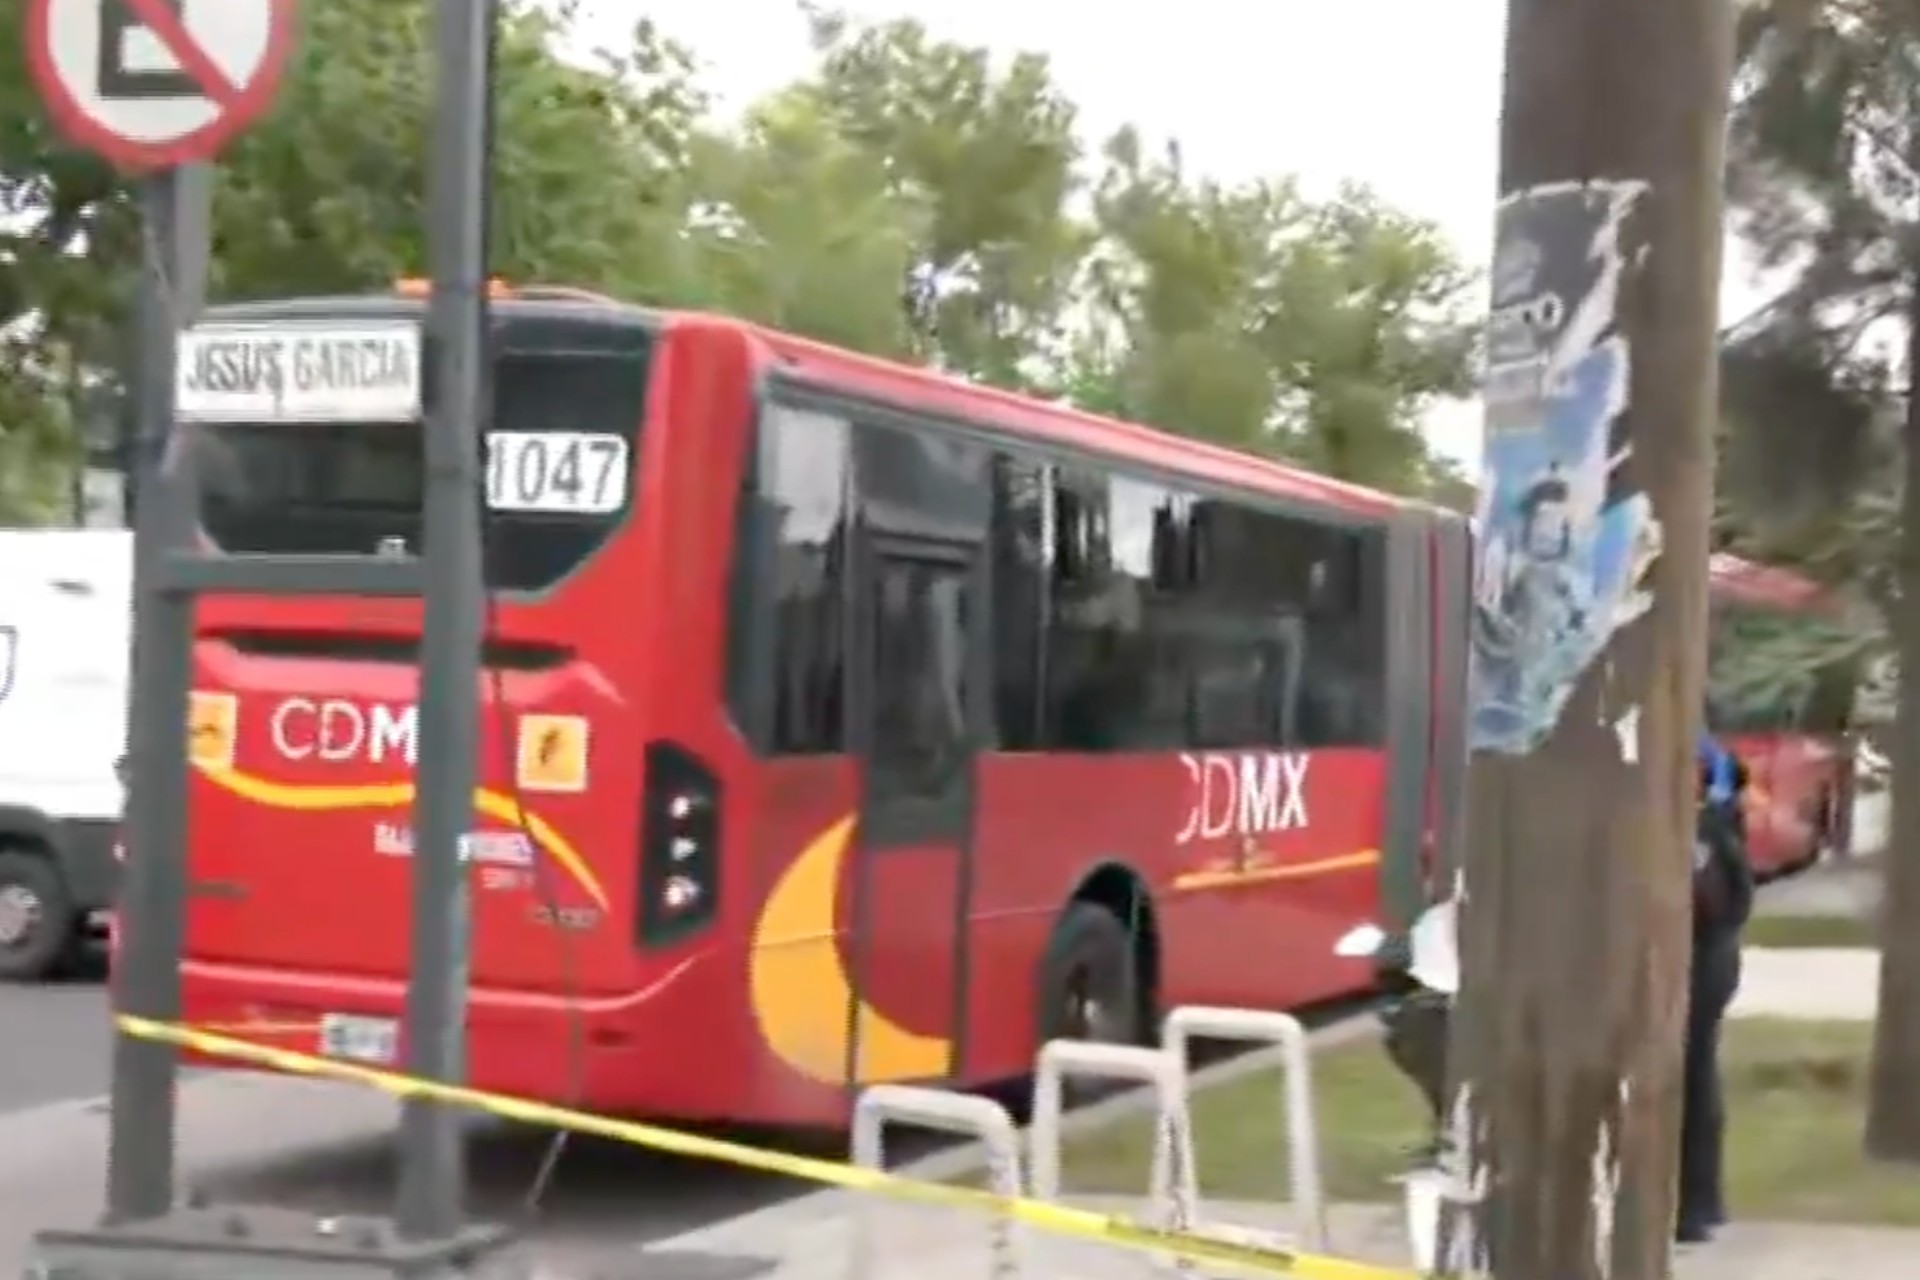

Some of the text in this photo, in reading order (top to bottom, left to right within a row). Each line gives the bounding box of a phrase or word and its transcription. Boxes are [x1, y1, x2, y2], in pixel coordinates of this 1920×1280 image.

[186, 339, 412, 393] JESUS GARCIA
[492, 438, 620, 504] 1047
[271, 698, 418, 764] CDM
